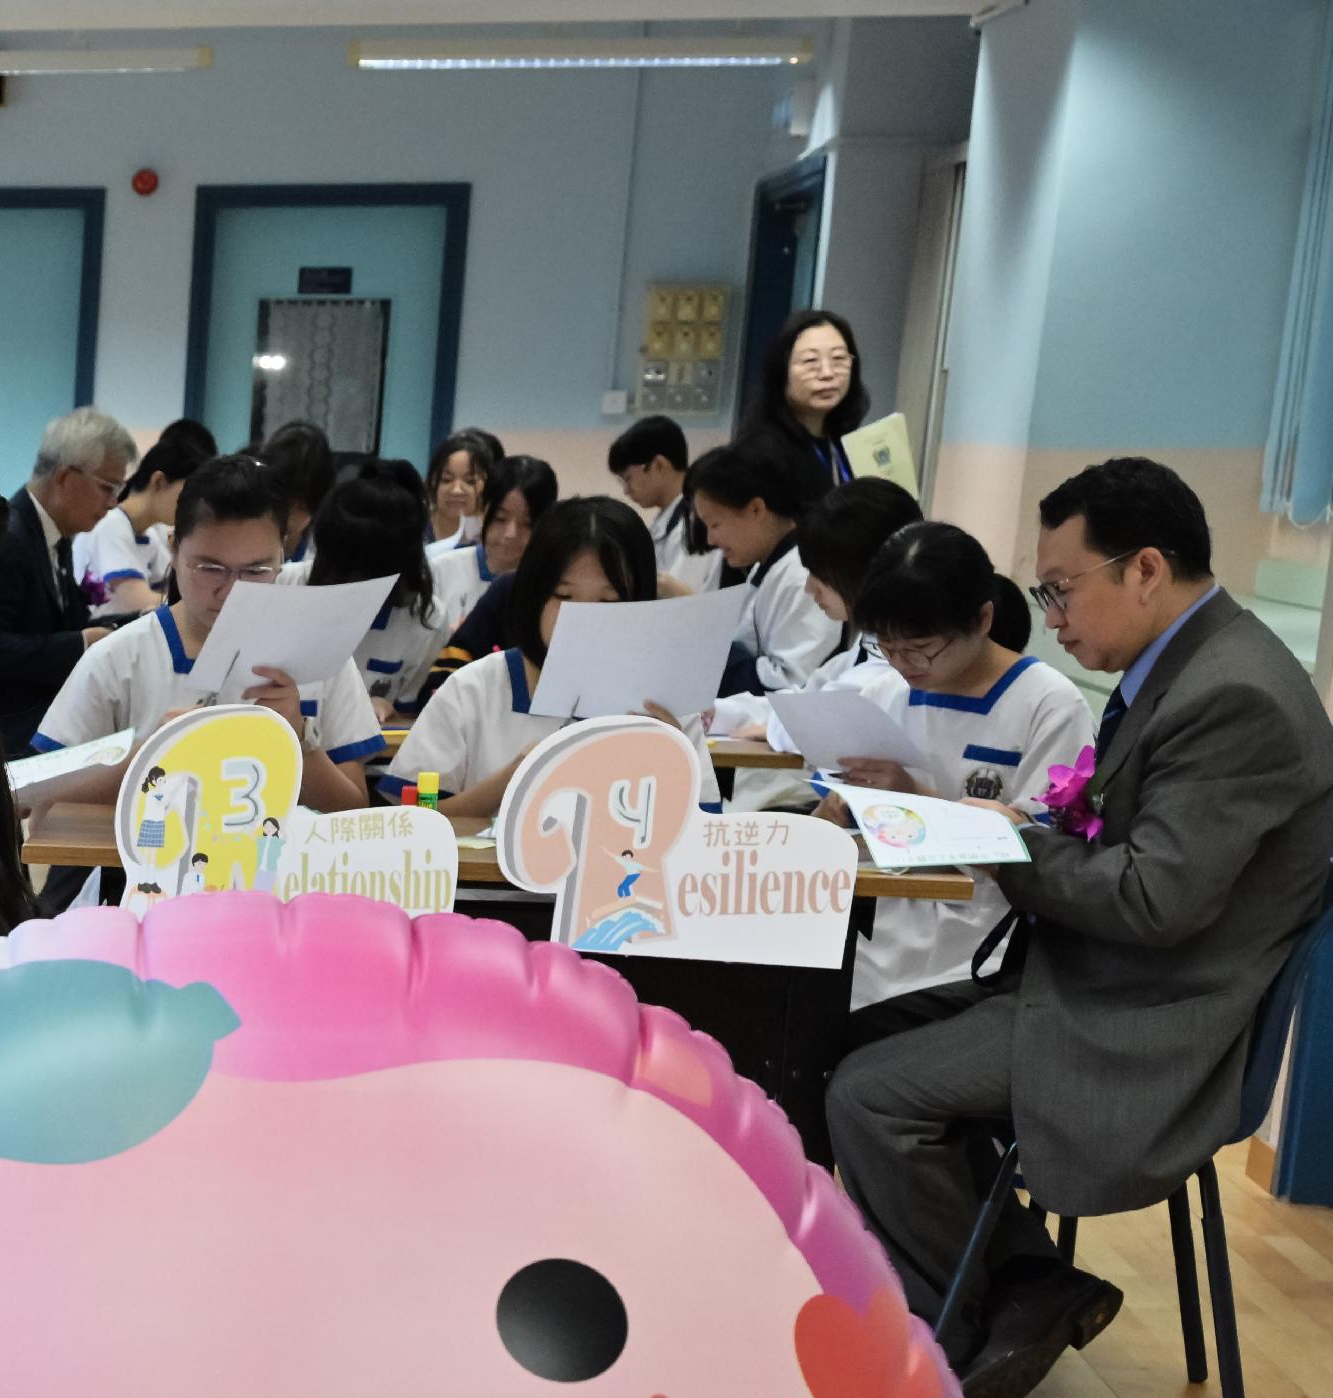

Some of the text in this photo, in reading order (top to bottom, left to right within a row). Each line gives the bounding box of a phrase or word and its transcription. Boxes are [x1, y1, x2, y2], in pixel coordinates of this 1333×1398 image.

[220, 756, 267, 832] 3
[304, 811, 414, 845] 人際關係
[702, 819, 790, 848] 抗逆力
